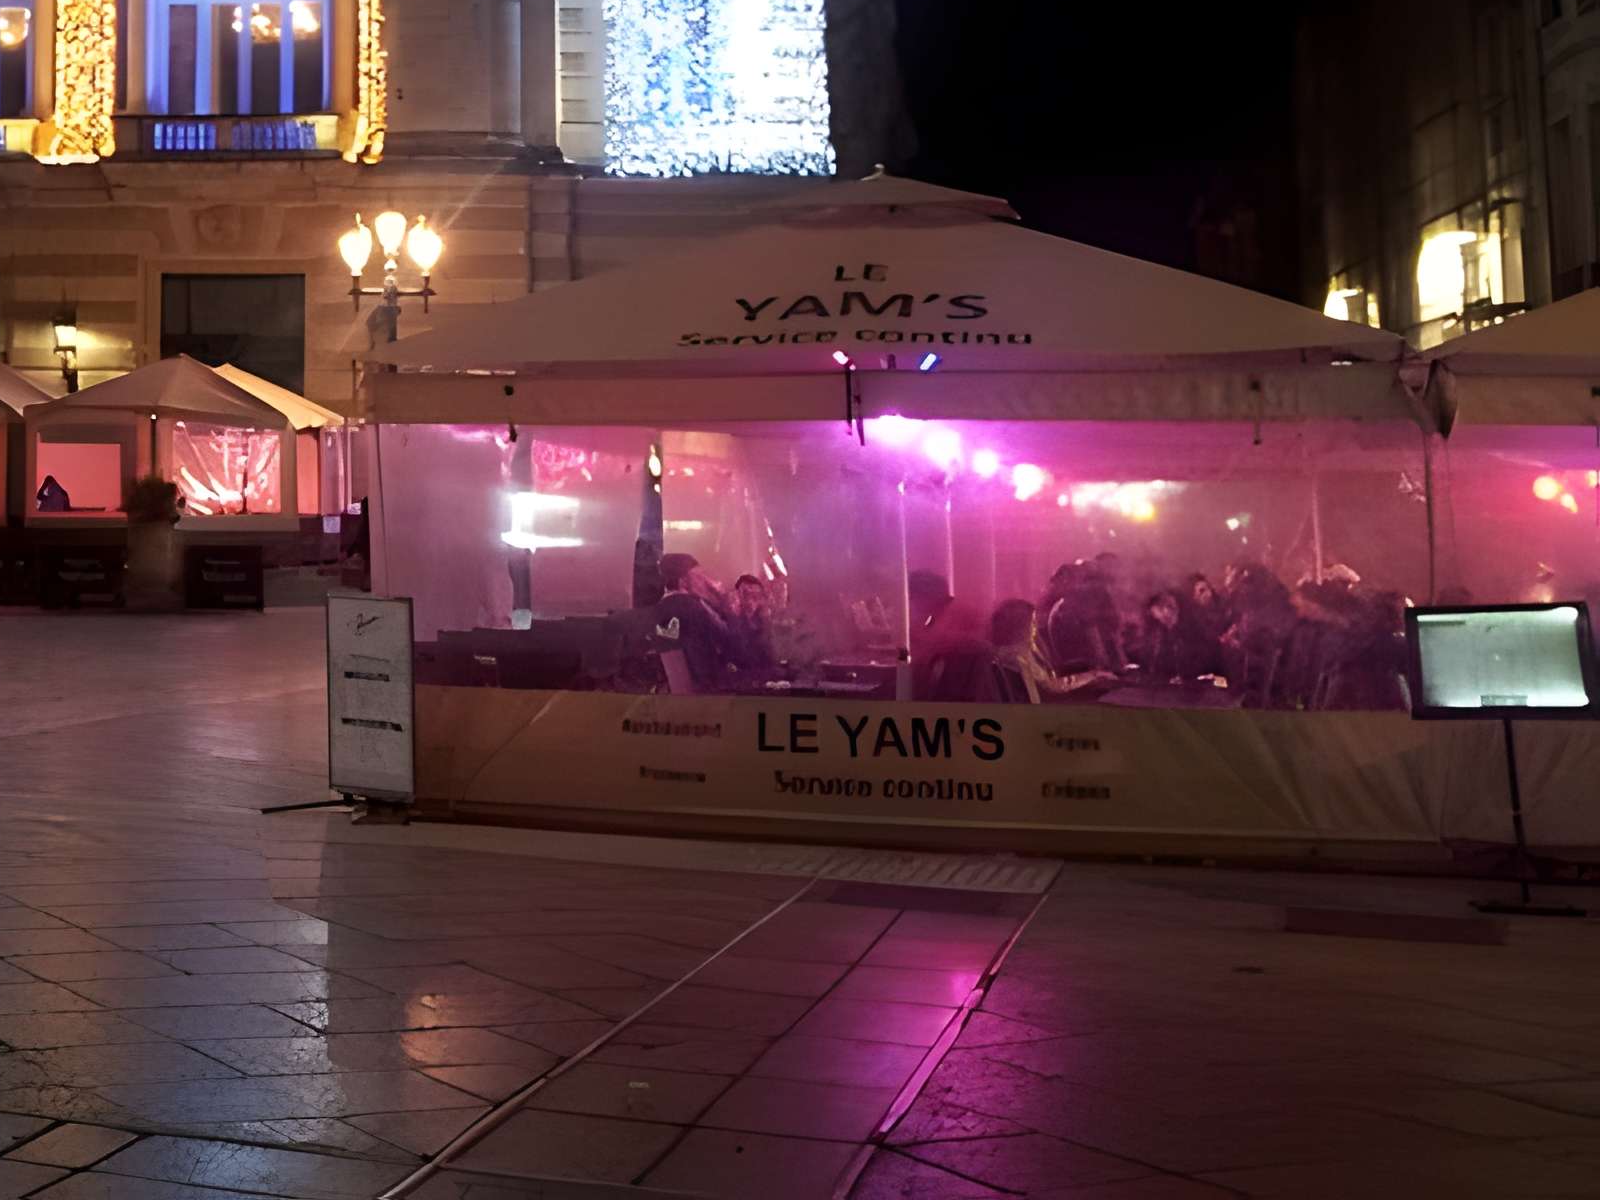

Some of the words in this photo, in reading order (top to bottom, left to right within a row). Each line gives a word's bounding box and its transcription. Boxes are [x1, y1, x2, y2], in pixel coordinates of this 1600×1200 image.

[834, 263, 888, 282] LE
[736, 291, 988, 321] YAM'S
[677, 330, 838, 346] Service
[856, 329, 1032, 345] continu
[758, 712, 820, 753] LE
[835, 714, 1005, 761] YAM'S
